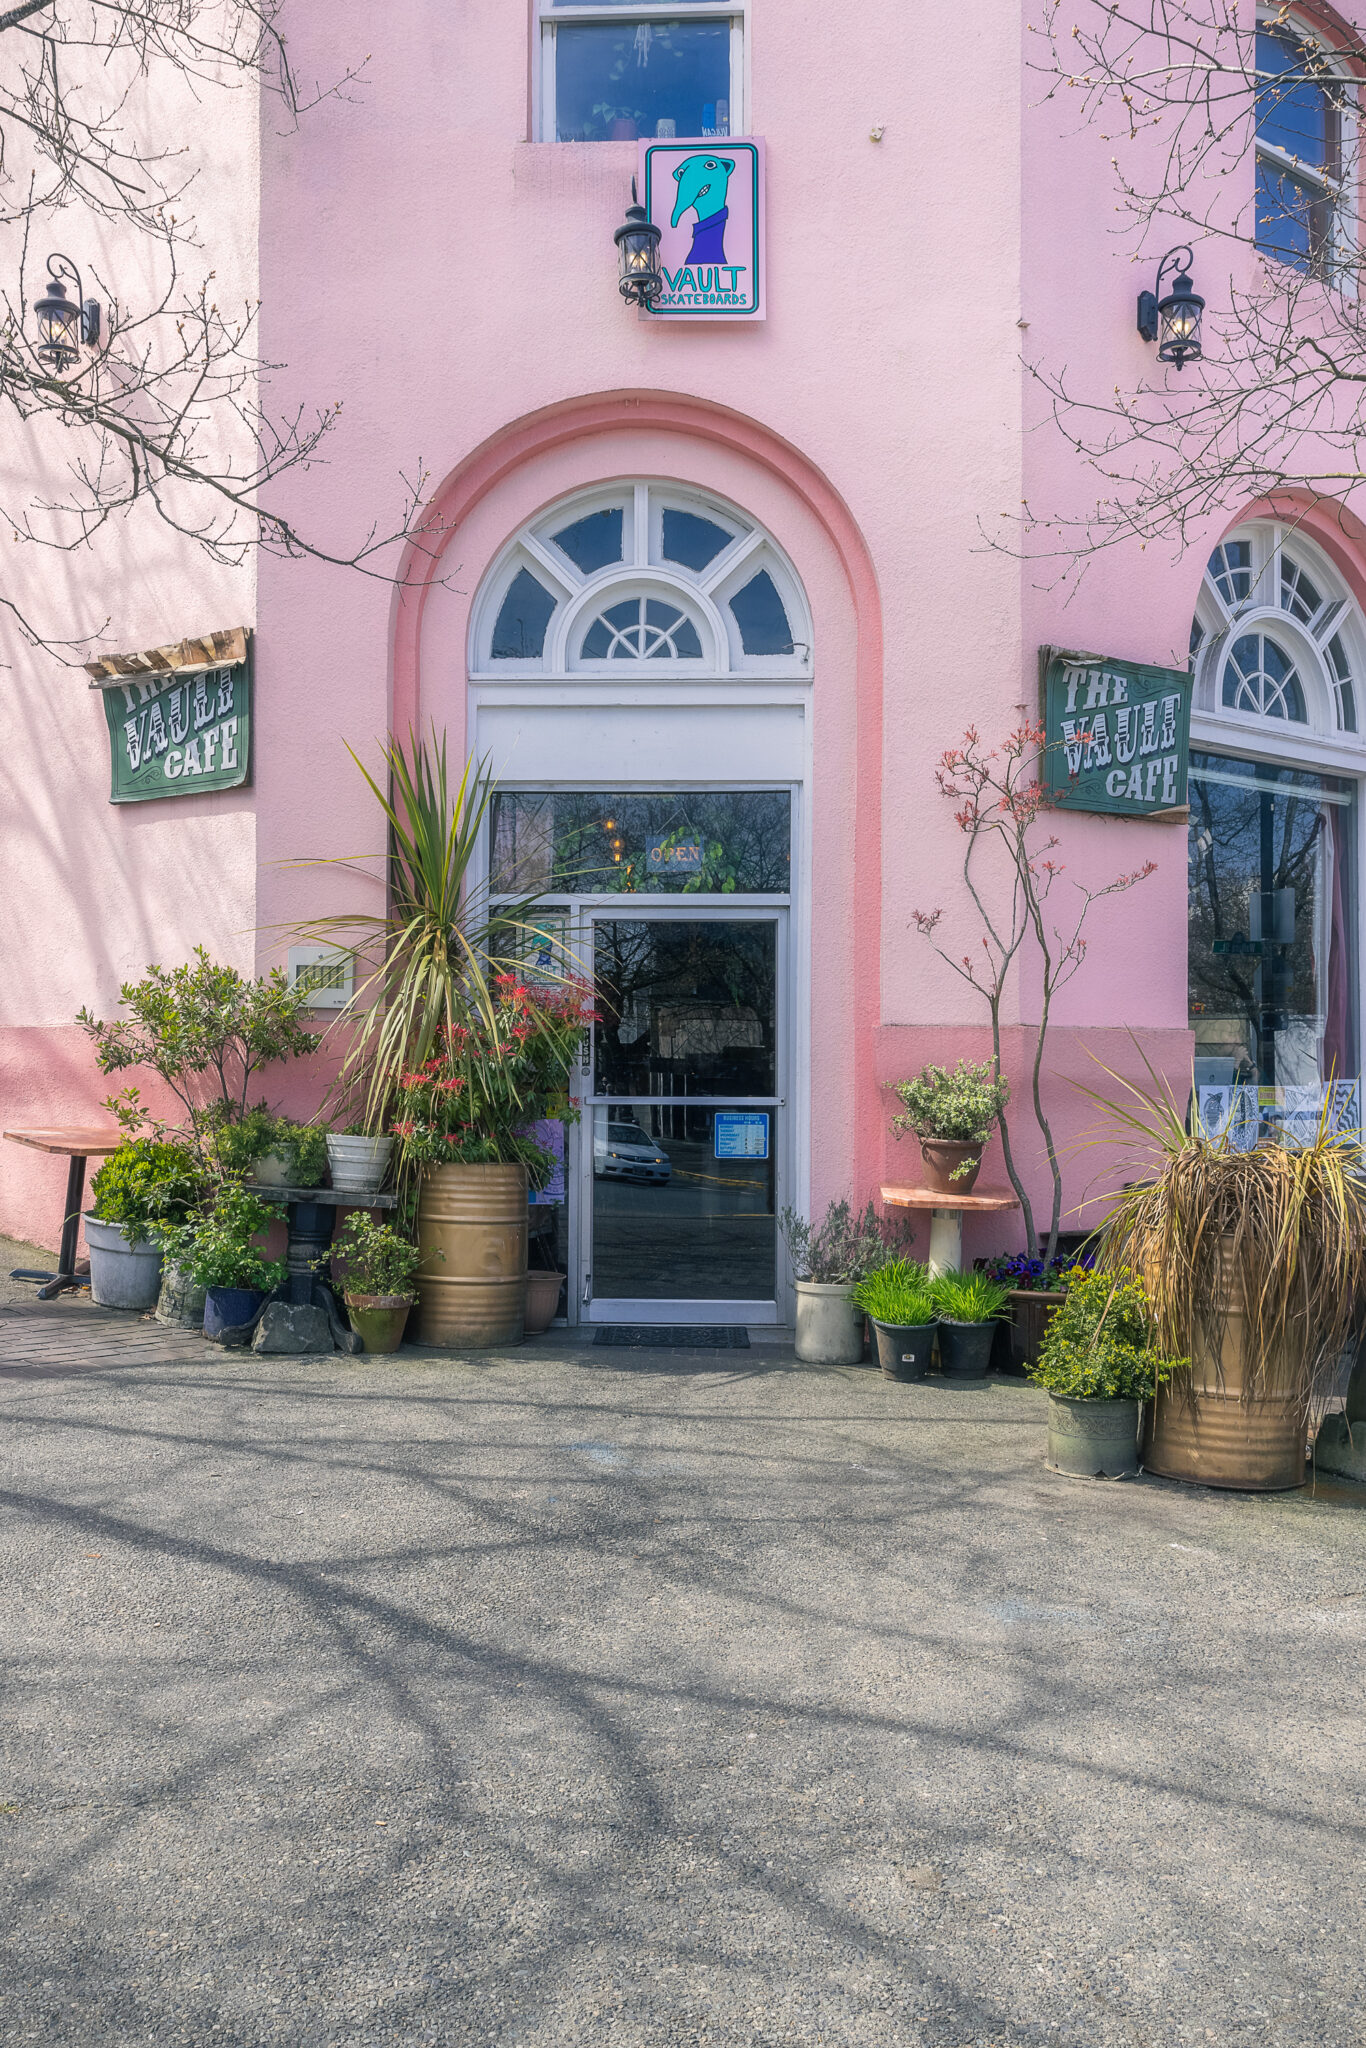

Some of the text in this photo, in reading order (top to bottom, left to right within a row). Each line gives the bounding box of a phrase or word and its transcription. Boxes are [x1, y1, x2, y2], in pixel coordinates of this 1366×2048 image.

[661, 294, 746, 305] SKATEBOARDS
[662, 266, 746, 292] VAULT
[1062, 665, 1128, 713] THE
[123, 667, 234, 773] VAULT
[1060, 693, 1181, 775] VAULT
[163, 715, 238, 779] CAFE
[1105, 754, 1178, 804] CAFE
[651, 846, 699, 862] OPEN
